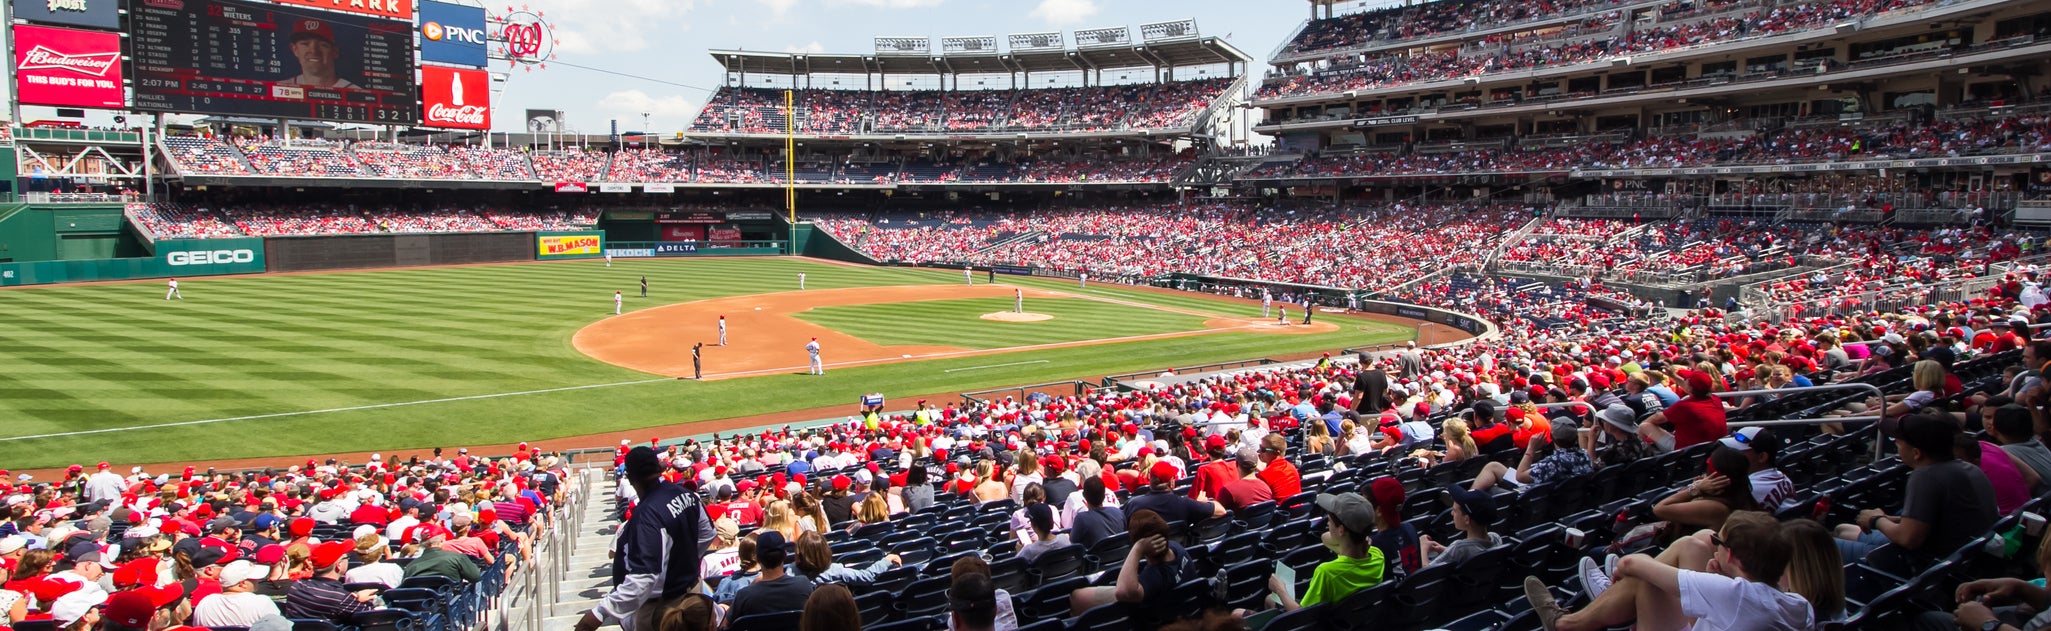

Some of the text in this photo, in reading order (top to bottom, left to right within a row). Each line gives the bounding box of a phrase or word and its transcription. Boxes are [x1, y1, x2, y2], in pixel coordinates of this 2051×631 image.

[224, 12, 252, 20] WIETERS
[444, 26, 485, 44] PNC
[26, 50, 110, 67] Budweiser
[26, 75, 116, 88] THIS BUD'S FOR YOU.
[378, 110, 410, 120] 3 2 1
[428, 103, 486, 124] Coca-Cola
[1625, 180, 1647, 188] PNC
[548, 239, 598, 253] W.B.MASON
[167, 249, 254, 265] GEICO
[666, 496, 684, 518] ASK
